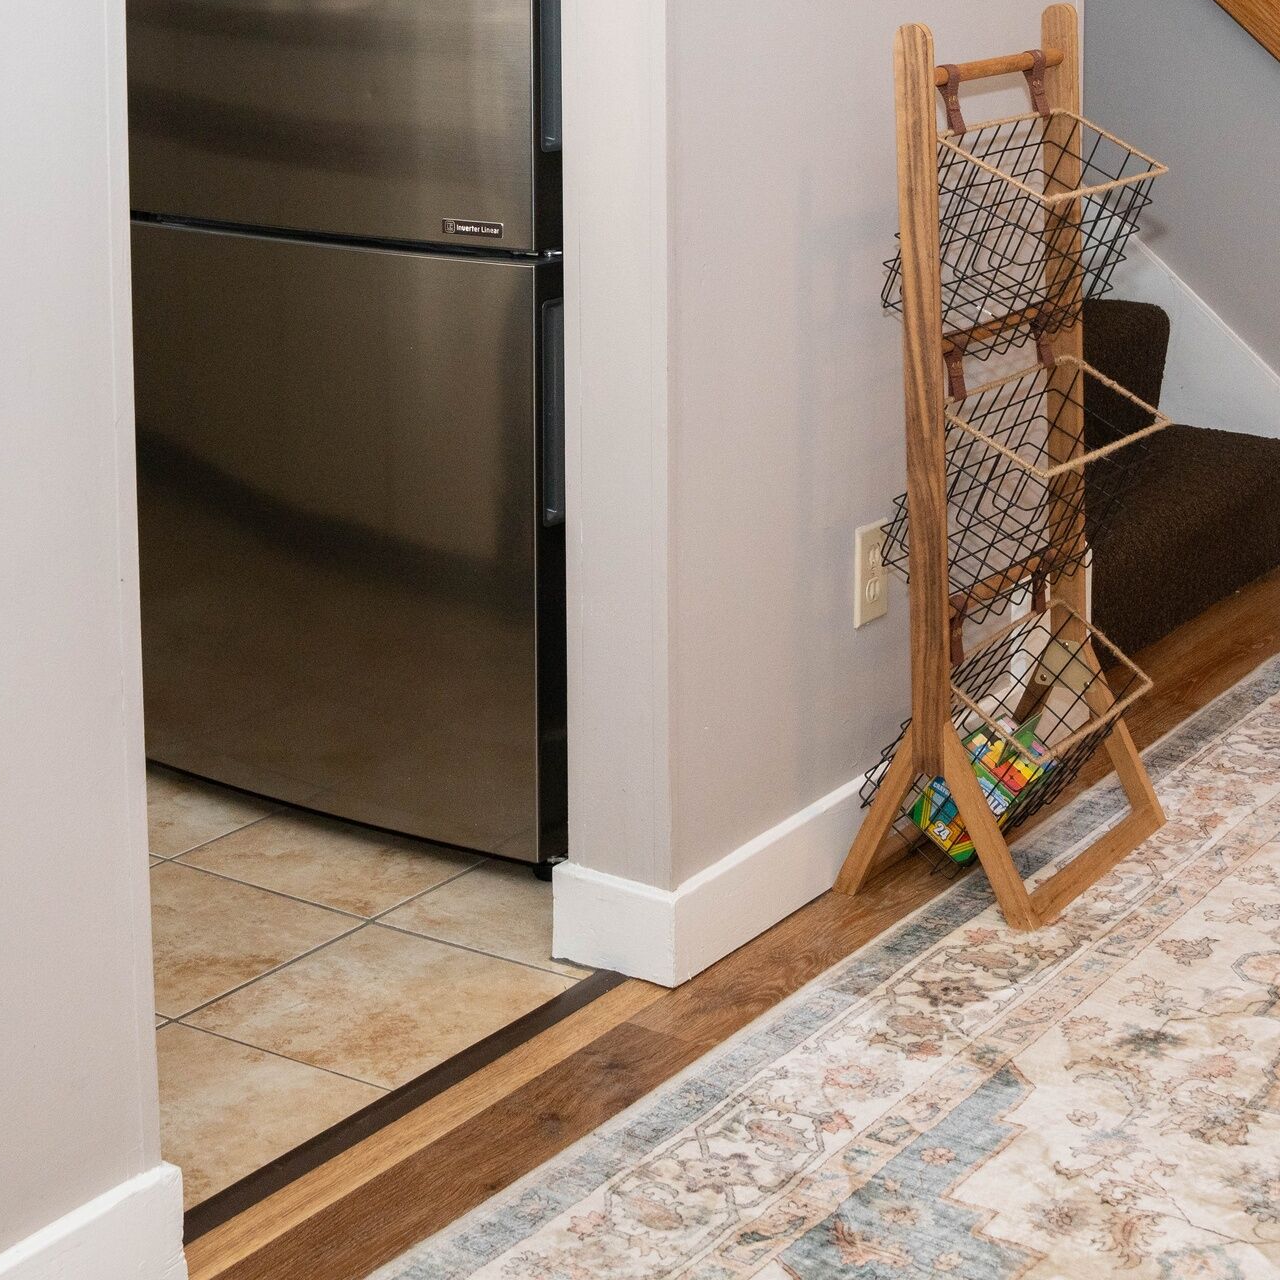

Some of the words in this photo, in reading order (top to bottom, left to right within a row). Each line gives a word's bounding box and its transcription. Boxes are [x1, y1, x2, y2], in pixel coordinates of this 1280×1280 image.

[456, 224, 480, 233] Inverter
[481, 226, 500, 234] Linear
[933, 822, 951, 841] 24
